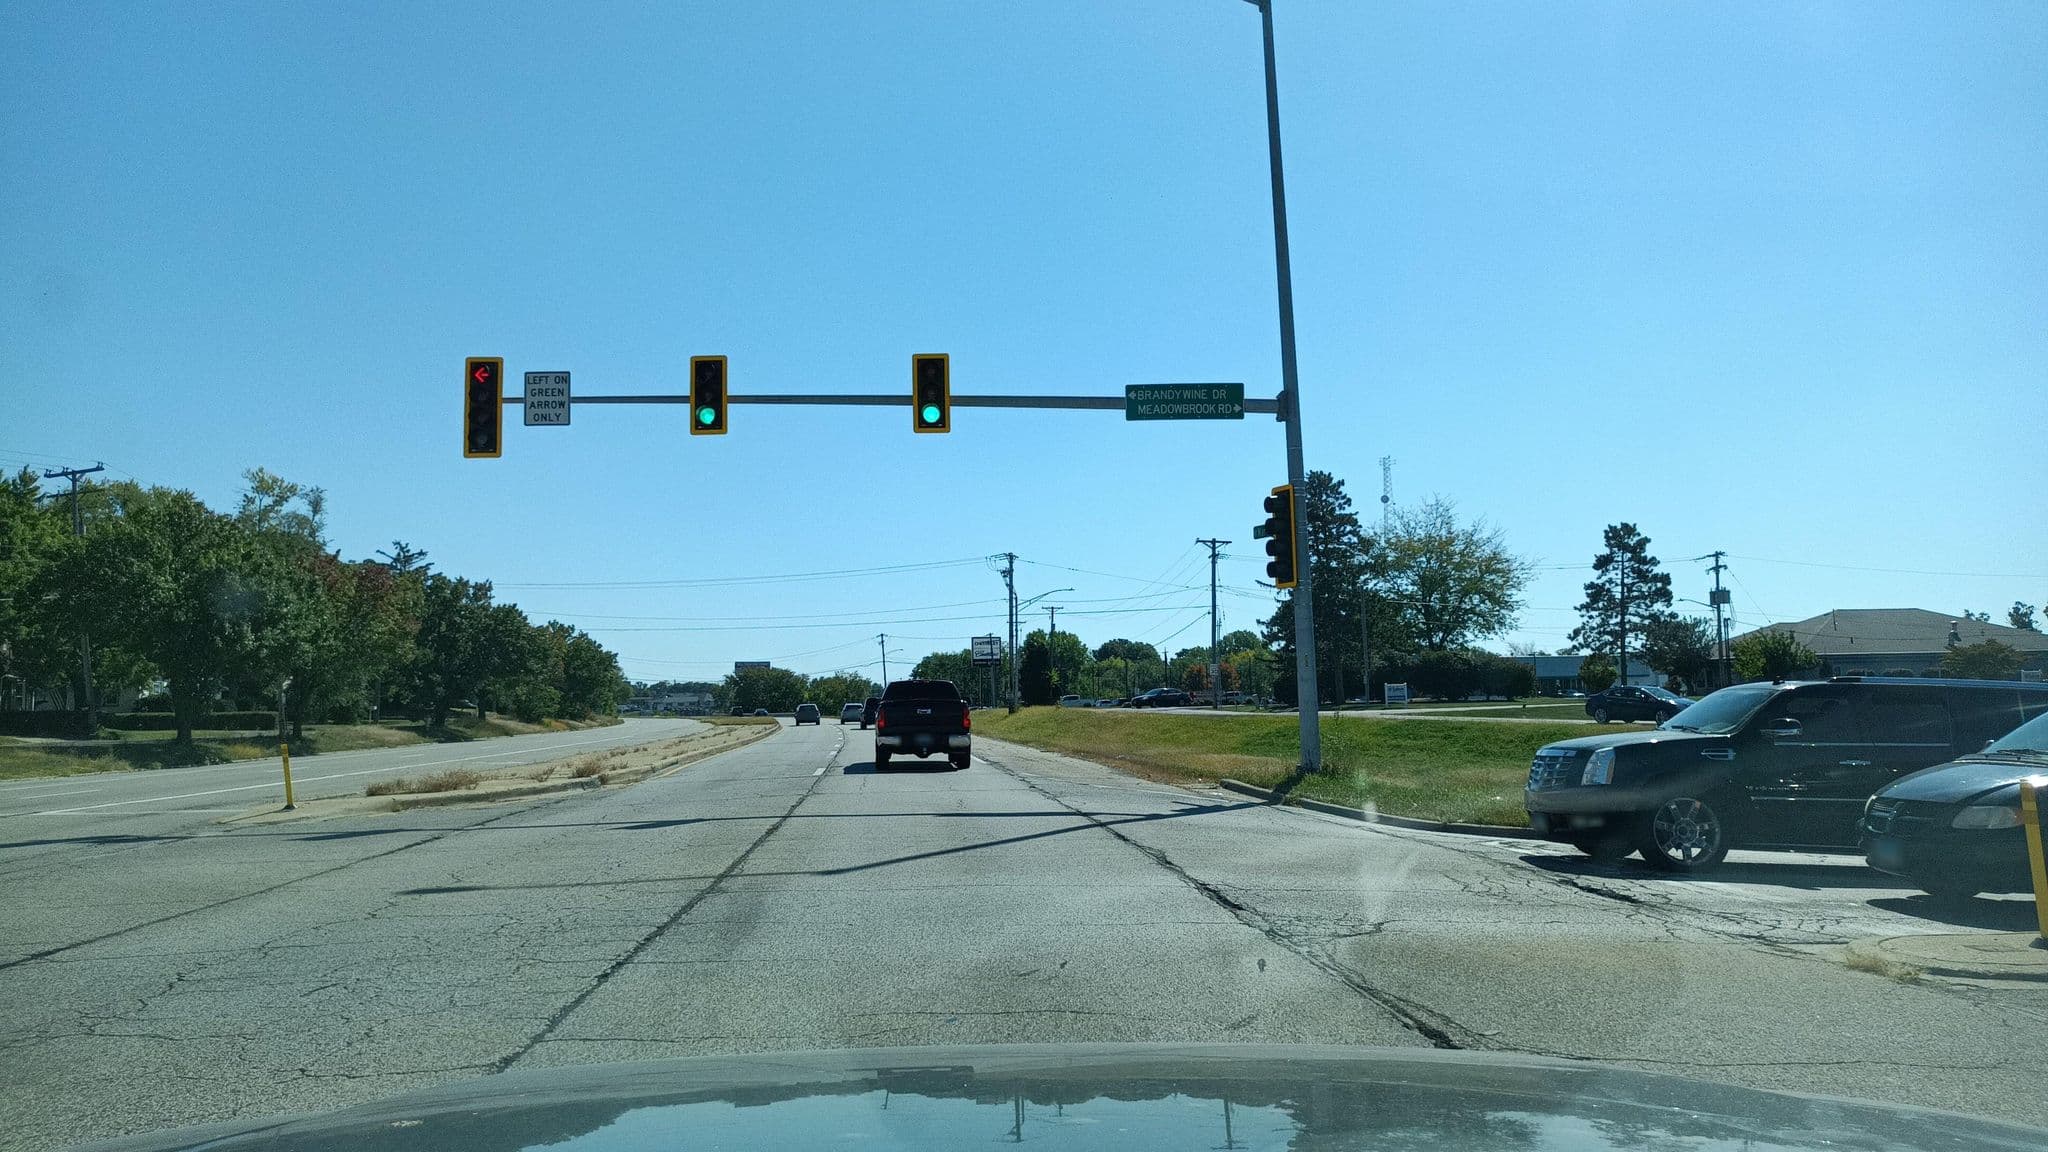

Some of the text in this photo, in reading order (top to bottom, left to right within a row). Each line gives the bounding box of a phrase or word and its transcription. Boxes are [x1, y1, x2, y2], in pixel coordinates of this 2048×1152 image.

[528, 376, 568, 384] LEFT ON
[530, 388, 564, 397] GREEN
[1137, 389, 1227, 400] BRANDYWINE DR
[529, 400, 566, 410] ARROW
[1137, 403, 1232, 415] MEADOWBROOK RD
[533, 413, 562, 422] ONLY
